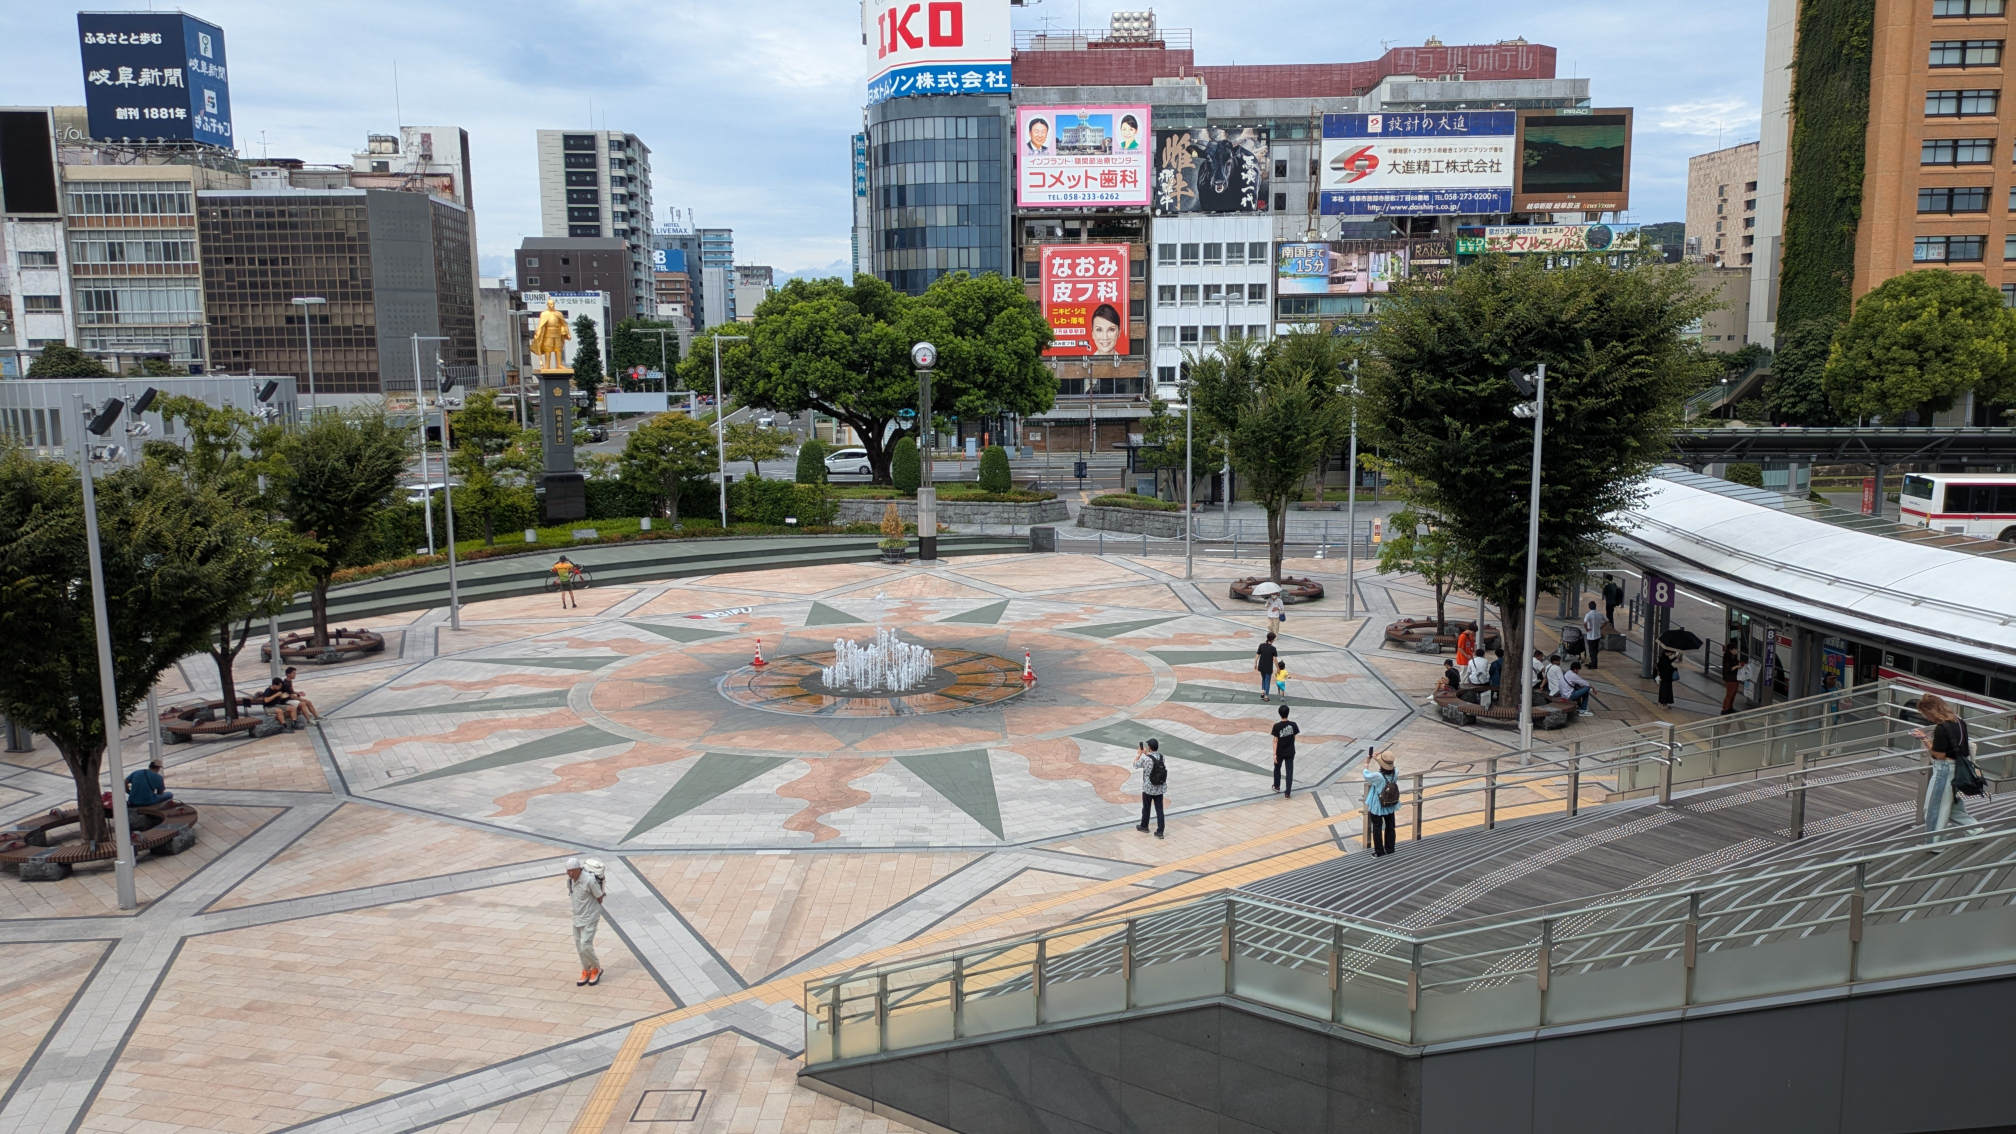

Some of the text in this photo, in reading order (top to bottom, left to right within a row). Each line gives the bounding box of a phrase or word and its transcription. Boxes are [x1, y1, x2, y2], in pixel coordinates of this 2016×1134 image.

[84, 32, 162, 45] ふるさとと歩む
[878, 2, 963, 60] IKO
[88, 66, 184, 88] 岐阜新聞
[189, 58, 227, 82] 岐阜新聞
[868, 70, 1008, 104] 日本トムソン株式会社
[115, 107, 187, 120] 創刊 1881年
[1387, 115, 1468, 132] 設計の大進
[1387, 159, 1502, 175] 大進精工株式会社
[1029, 169, 1138, 189] コメット歯科
[1282, 246, 1325, 258] 南国まで
[1052, 257, 1118, 277] なおみ
[1296, 259, 1325, 272] 15分
[1052, 281, 1118, 303] 皮フ科
[1642, 579, 1649, 598] 8
[1656, 583, 1668, 602] 8
[1768, 631, 1774, 639] 8
